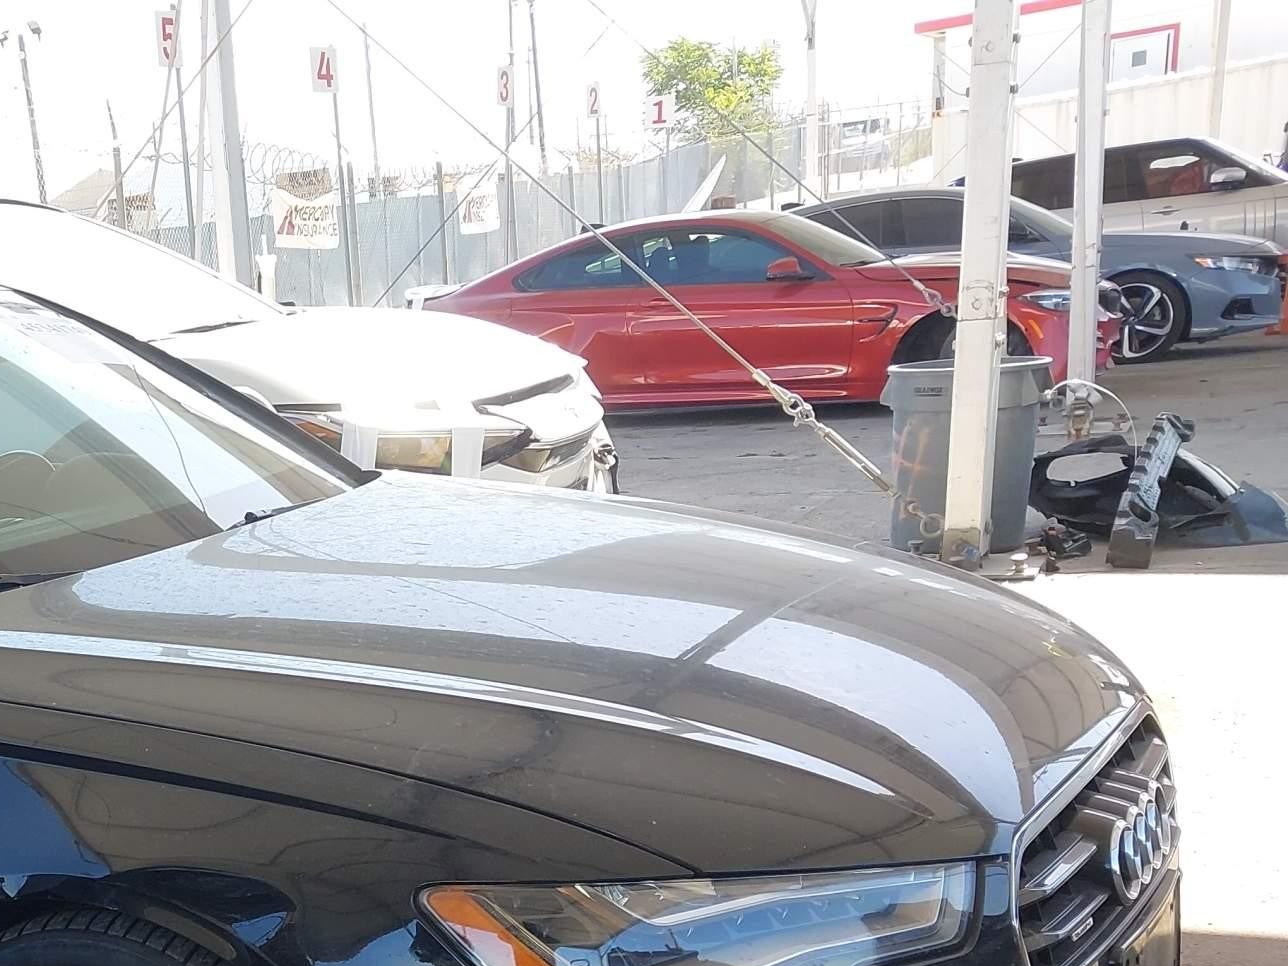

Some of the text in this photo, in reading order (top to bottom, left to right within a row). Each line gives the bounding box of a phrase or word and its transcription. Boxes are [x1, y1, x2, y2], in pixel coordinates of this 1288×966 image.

[161, 16, 175, 61] 5
[317, 51, 334, 88] 4
[499, 70, 509, 102] 3
[589, 87, 599, 115] 2
[652, 100, 667, 125] 1
[296, 223, 339, 237] NSURANCE
